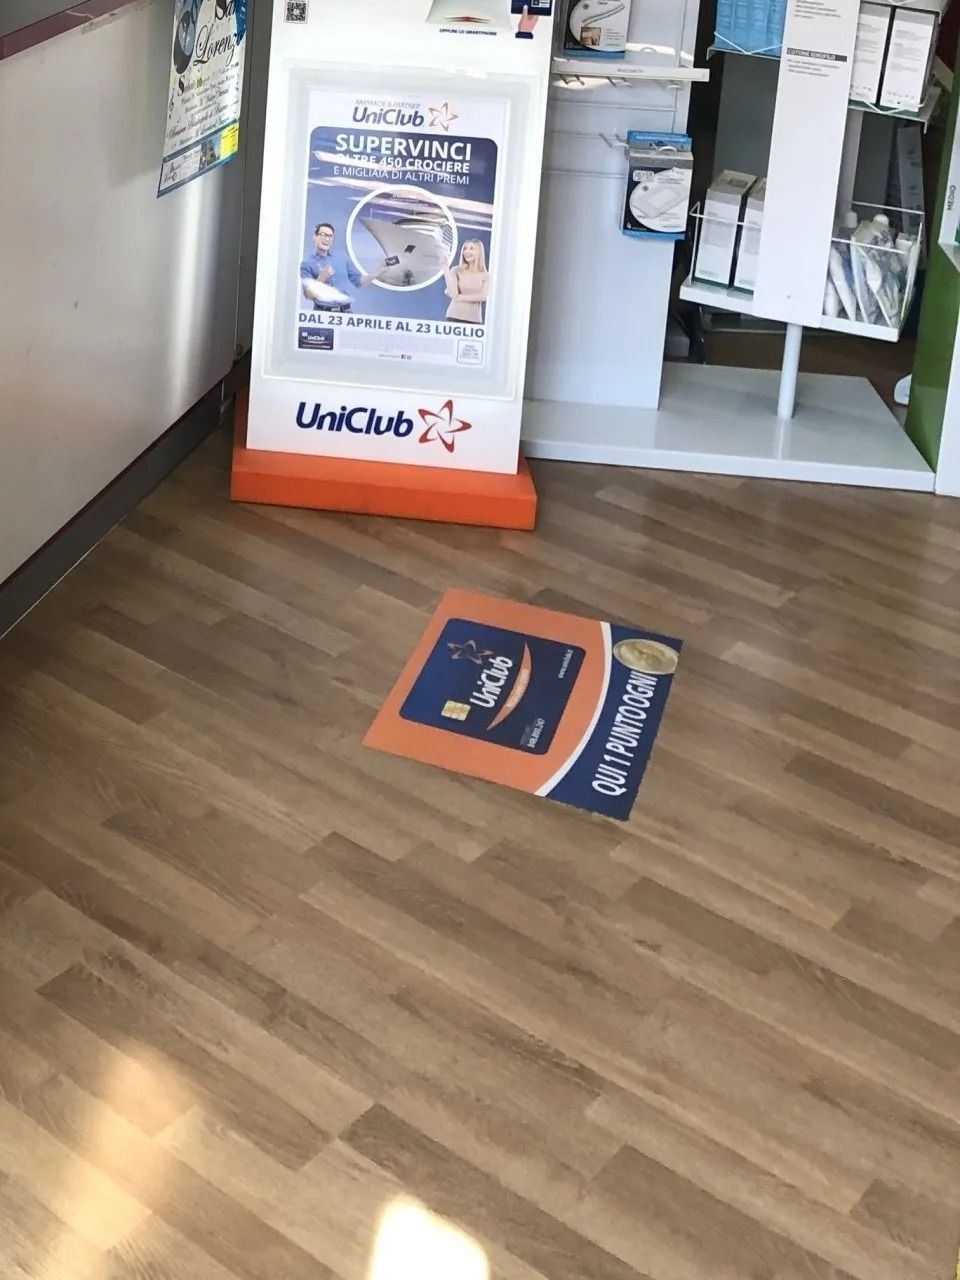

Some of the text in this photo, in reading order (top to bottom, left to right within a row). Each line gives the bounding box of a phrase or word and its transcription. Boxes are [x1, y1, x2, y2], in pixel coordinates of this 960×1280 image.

[352, 106, 425, 127] UniClub
[335, 134, 472, 161] SUPERVINCI
[336, 153, 470, 174] OLTRE 450 CROCIERE
[342, 166, 470, 185] MIGLIAIA DI ALTRI PREMI
[946, 184, 957, 213] MEDIO
[298, 312, 484, 339] DAL 23 APRILE AL 23 LUGLIO
[296, 401, 414, 438] UniClub
[469, 655, 513, 708] UniClub
[592, 669, 659, 797] QUI 1 PUNTO OGNI
